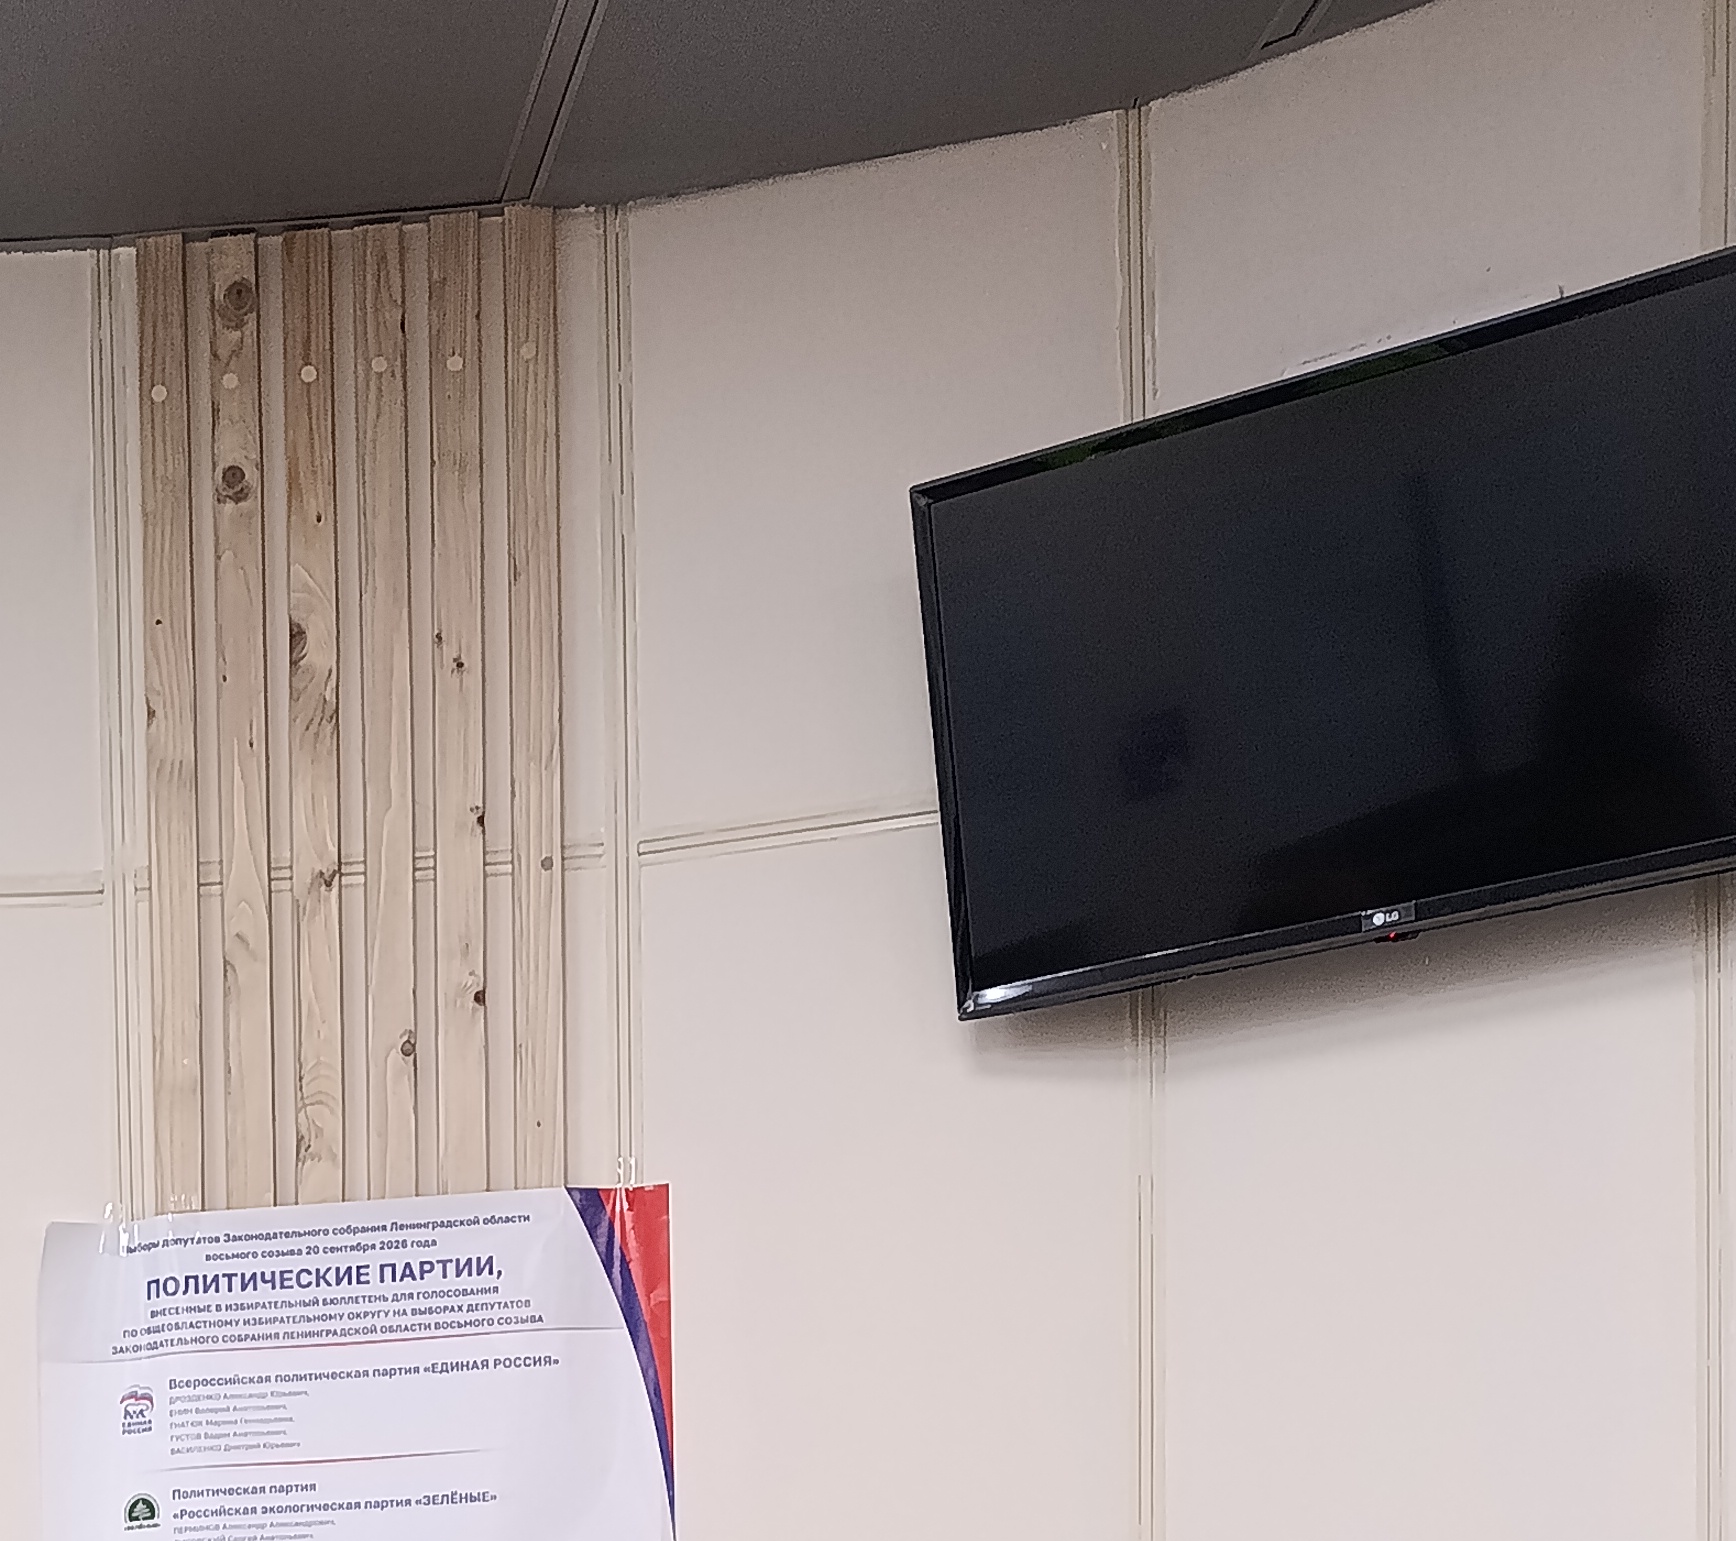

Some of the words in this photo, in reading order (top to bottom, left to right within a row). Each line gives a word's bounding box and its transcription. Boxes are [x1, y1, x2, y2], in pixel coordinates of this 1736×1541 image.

[1386, 911, 1400, 922] LG
[222, 1228, 330, 1242] Законодательного
[331, 1224, 388, 1236] собрания
[389, 1215, 480, 1231] Ленинградской
[482, 1214, 530, 1225] области
[205, 1250, 259, 1261] восьмого
[260, 1248, 303, 1258] созыва
[305, 1244, 320, 1256] 20
[321, 1241, 376, 1254] сентября
[410, 1238, 437, 1248] года
[146, 1265, 371, 1300] ПОЛИТИЧЕСКИЕ
[378, 1256, 502, 1282] ПАРТИИ,
[150, 1304, 213, 1318] ВНЕСЕННЫЕ
[224, 1296, 320, 1312] ИЗБИРАТЕЛЬНЫЙ
[321, 1294, 389, 1306] БЮЛЛЕТЕНЬ
[390, 1291, 414, 1303] ДЛЯ
[416, 1285, 499, 1300] ГОЛОСОВАНИЯ
[122, 1328, 138, 1338] ПО
[242, 1312, 345, 1326] ИЗБИРАТЕЛЬНОМУ
[347, 1309, 391, 1321] ОКРУГУ
[392, 1308, 408, 1318] НА
[410, 1303, 464, 1316] ВЫБОРАХ
[465, 1299, 531, 1313] ДЕПУТАТОВ
[221, 1331, 280, 1343] СОБРАНИЯ
[282, 1324, 378, 1340] ЛЕНИНГРАДСКОЙ
[379, 1322, 432, 1334] ОБЛАСТИ
[433, 1317, 495, 1330] ВОСЬМОГО
[496, 1314, 544, 1326] СОЗЫВА
[168, 1374, 272, 1390] Всероссийская
[274, 1369, 369, 1383] политическая
[372, 1366, 420, 1379] партия
[422, 1358, 489, 1374] «ЕДИНАЯ
[493, 1355, 559, 1369] РОССИЯ»
[171, 1485, 266, 1500] Политическая
[268, 1483, 316, 1495] партия
[172, 1505, 257, 1519] «Российская
[260, 1501, 361, 1514] экологическая
[363, 1498, 412, 1511] партия
[414, 1490, 497, 1506] «ЗЕЛЁНЫЕ»
